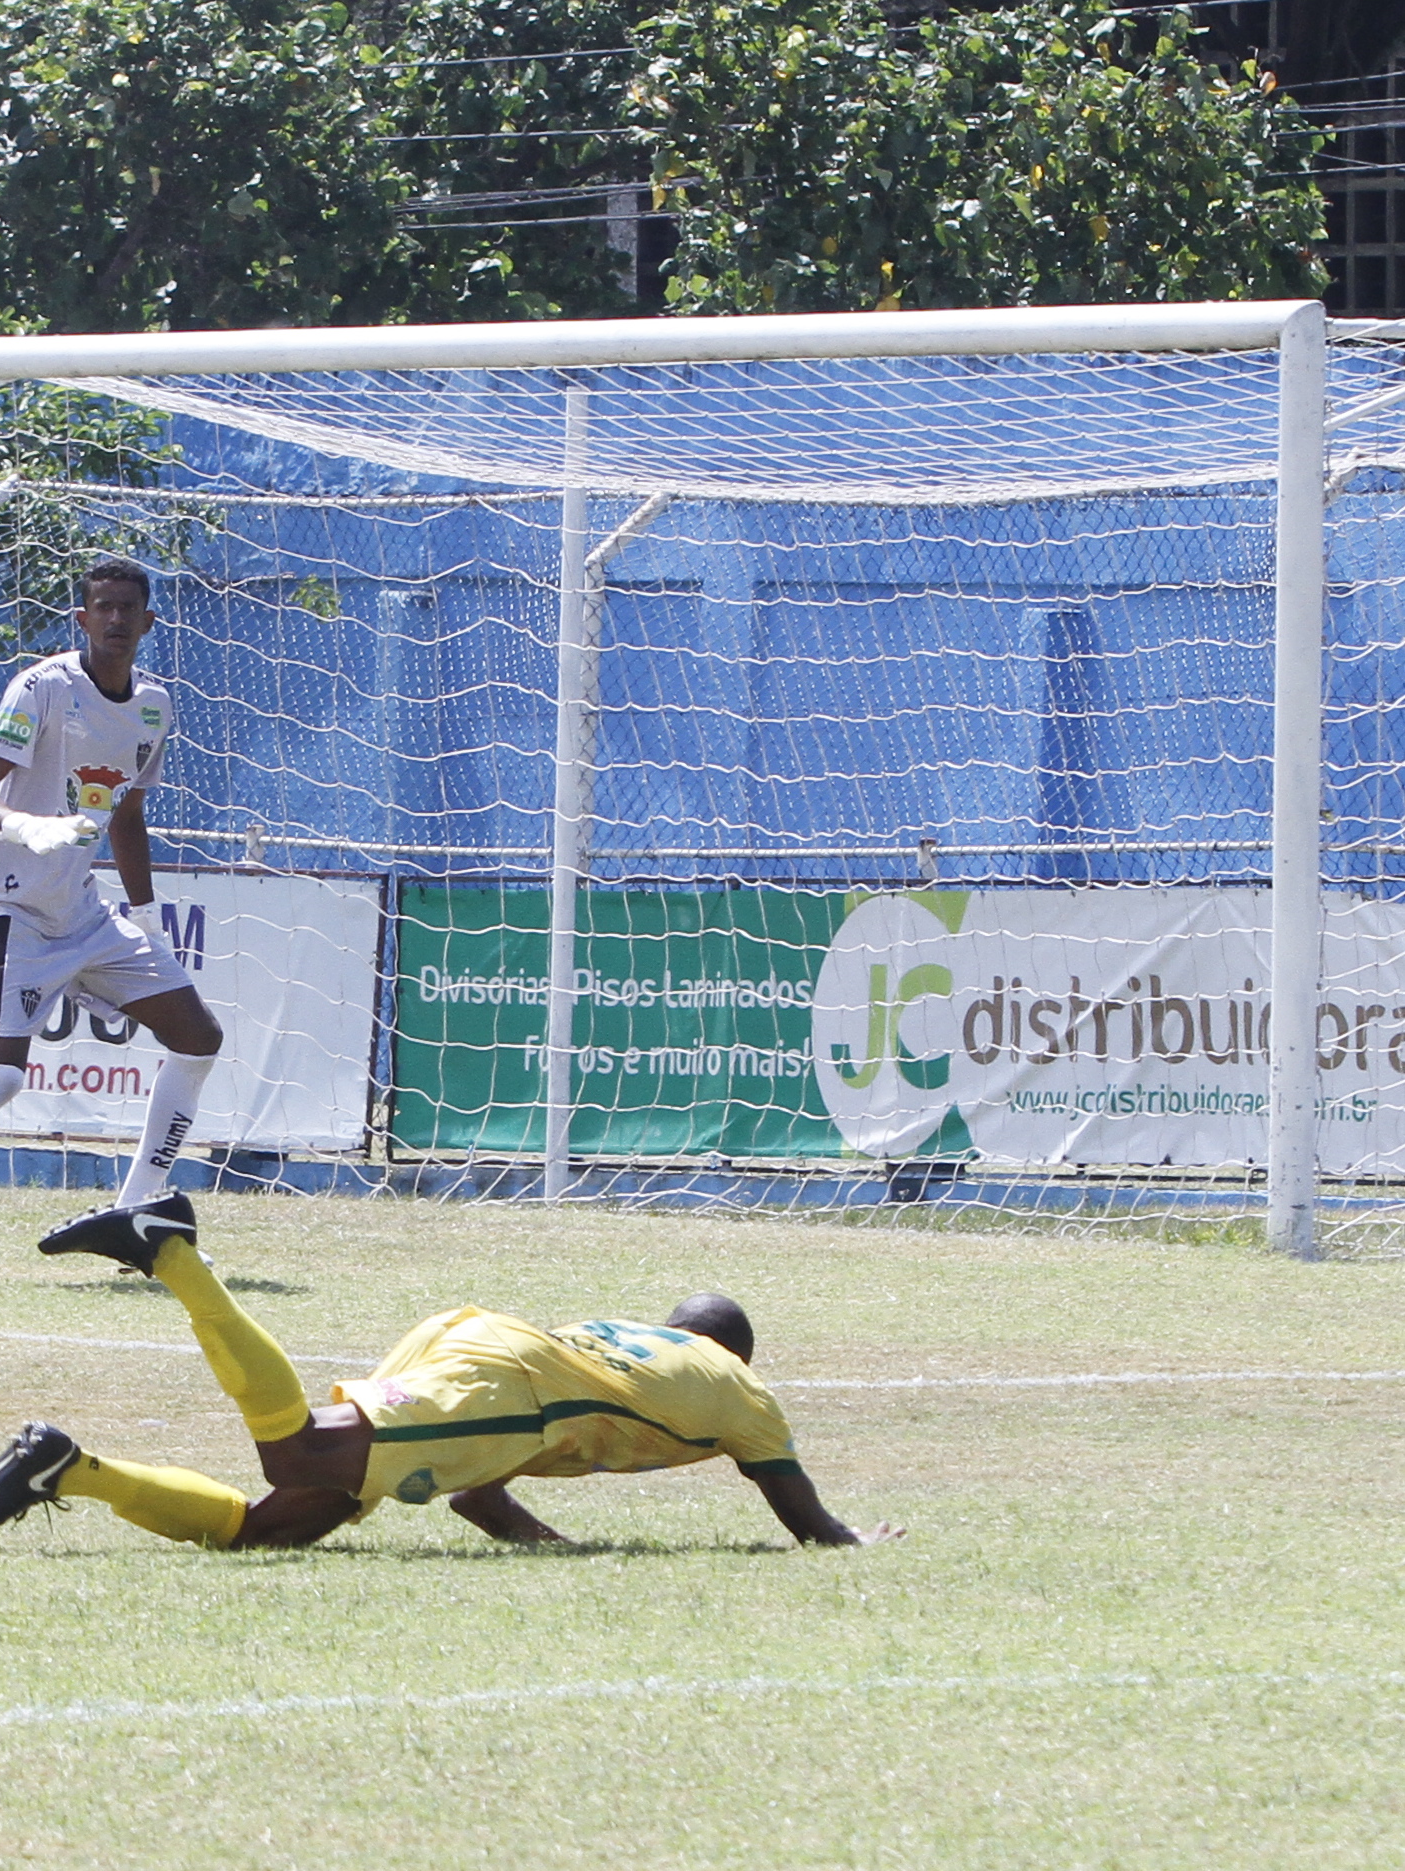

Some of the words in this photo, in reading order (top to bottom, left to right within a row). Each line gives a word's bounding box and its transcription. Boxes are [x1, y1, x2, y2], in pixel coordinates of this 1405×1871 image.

[420, 965, 551, 1006] Divisórias
[572, 968, 657, 1008] Pisos
[664, 969, 813, 1010] Laminados
[831, 964, 953, 1089] JC
[524, 1034, 615, 1074] Foos
[625, 1046, 641, 1075] e
[649, 1037, 722, 1077] muito
[728, 1036, 811, 1078] mais!
[149, 1110, 193, 1170] Rhumy
